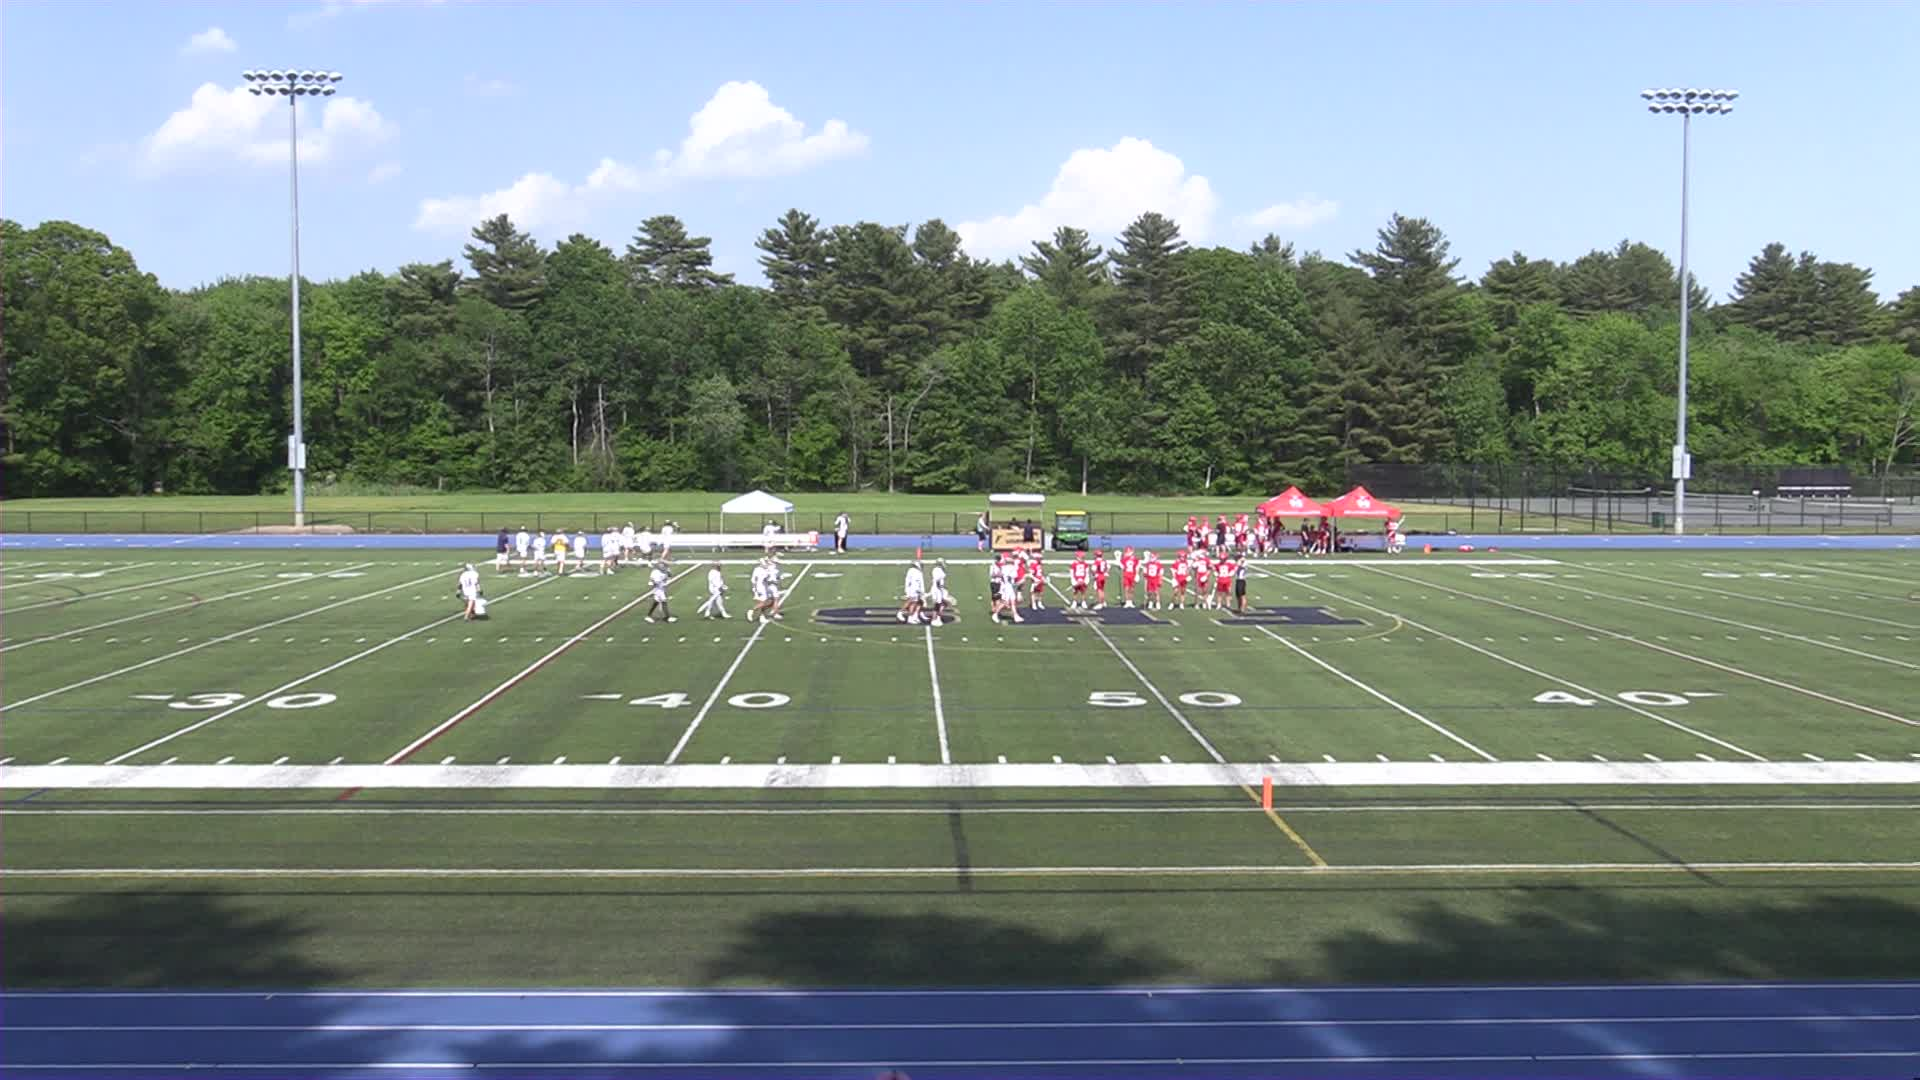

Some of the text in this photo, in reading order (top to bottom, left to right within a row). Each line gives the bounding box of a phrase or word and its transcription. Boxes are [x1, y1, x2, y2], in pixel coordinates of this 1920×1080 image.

[168, 691, 337, 710] 30
[628, 691, 792, 709] 40
[1087, 690, 1243, 708] 50
[1532, 690, 1690, 707] 40
